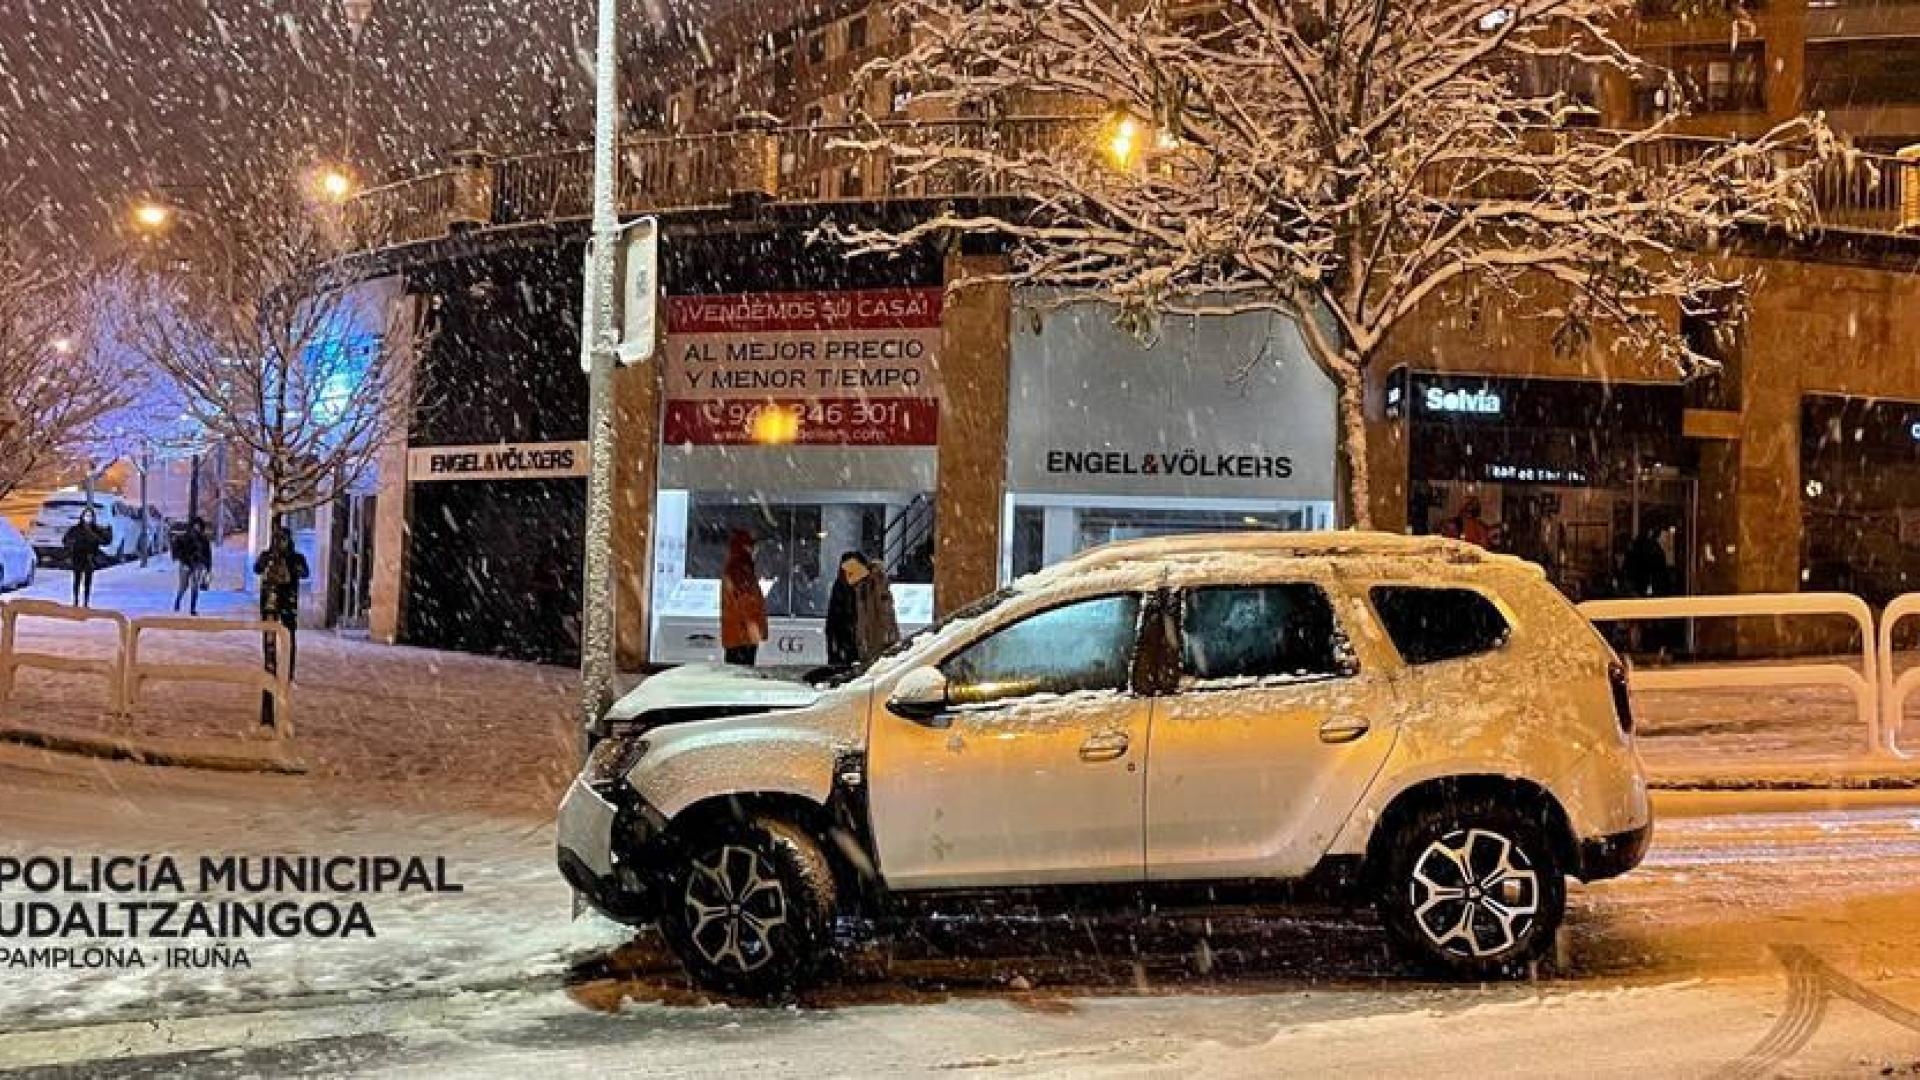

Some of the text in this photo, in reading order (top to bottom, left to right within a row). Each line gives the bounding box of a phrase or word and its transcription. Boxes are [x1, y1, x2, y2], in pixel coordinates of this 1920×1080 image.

[857, 299, 928, 317] CASA!
[684, 339, 924, 361] AL MEJOR PRECIO
[686, 367, 921, 388] Y MENOR TIEMPO
